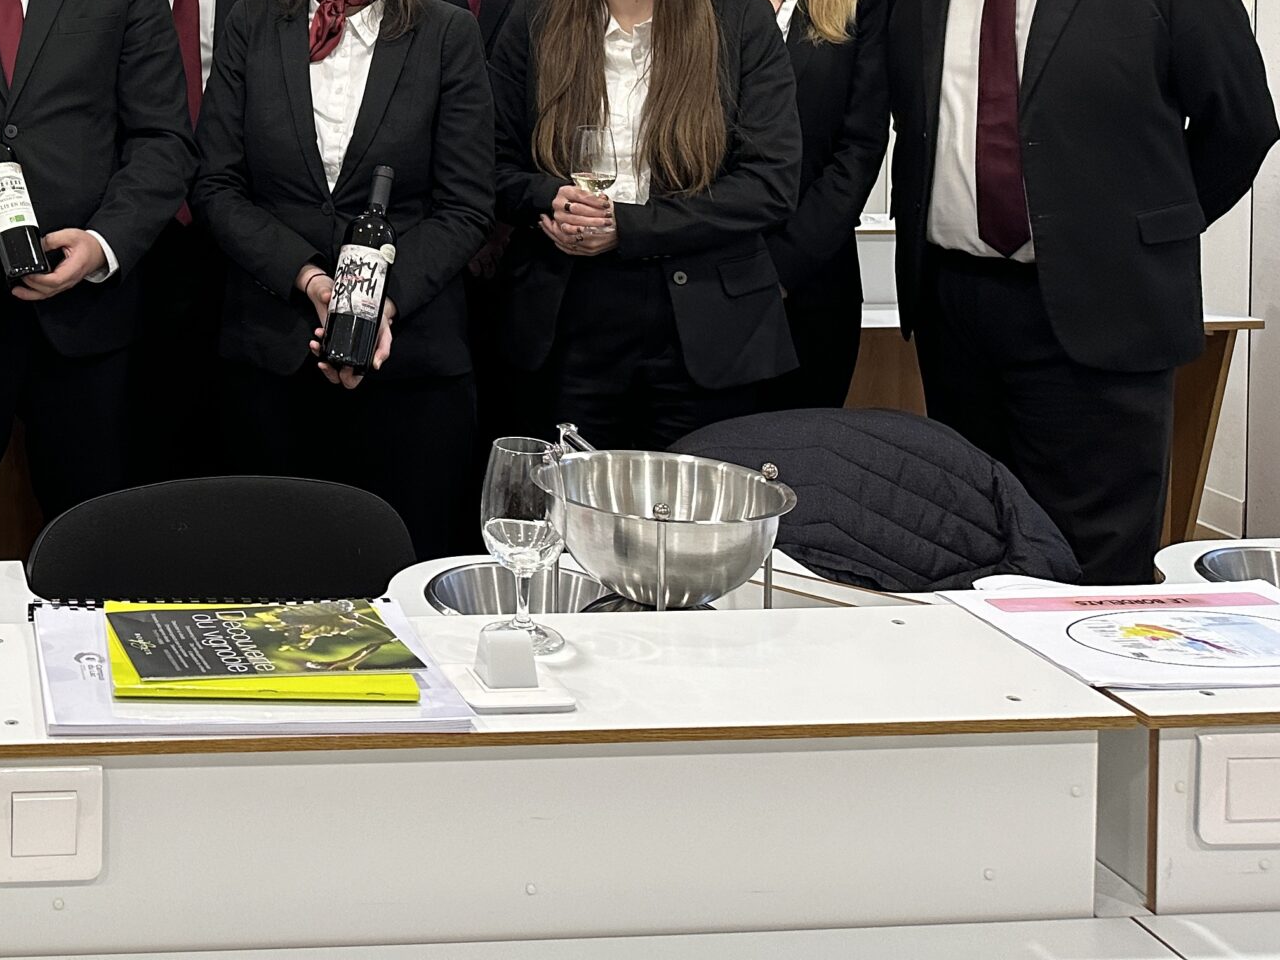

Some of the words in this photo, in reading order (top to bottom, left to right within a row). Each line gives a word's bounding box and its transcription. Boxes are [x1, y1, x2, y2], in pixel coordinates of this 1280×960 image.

[332, 278, 378, 300] SOUTH
[1075, 598, 1166, 606] BORDELAIS
[191, 613, 217, 629] du
[201, 630, 249, 673] vignoble
